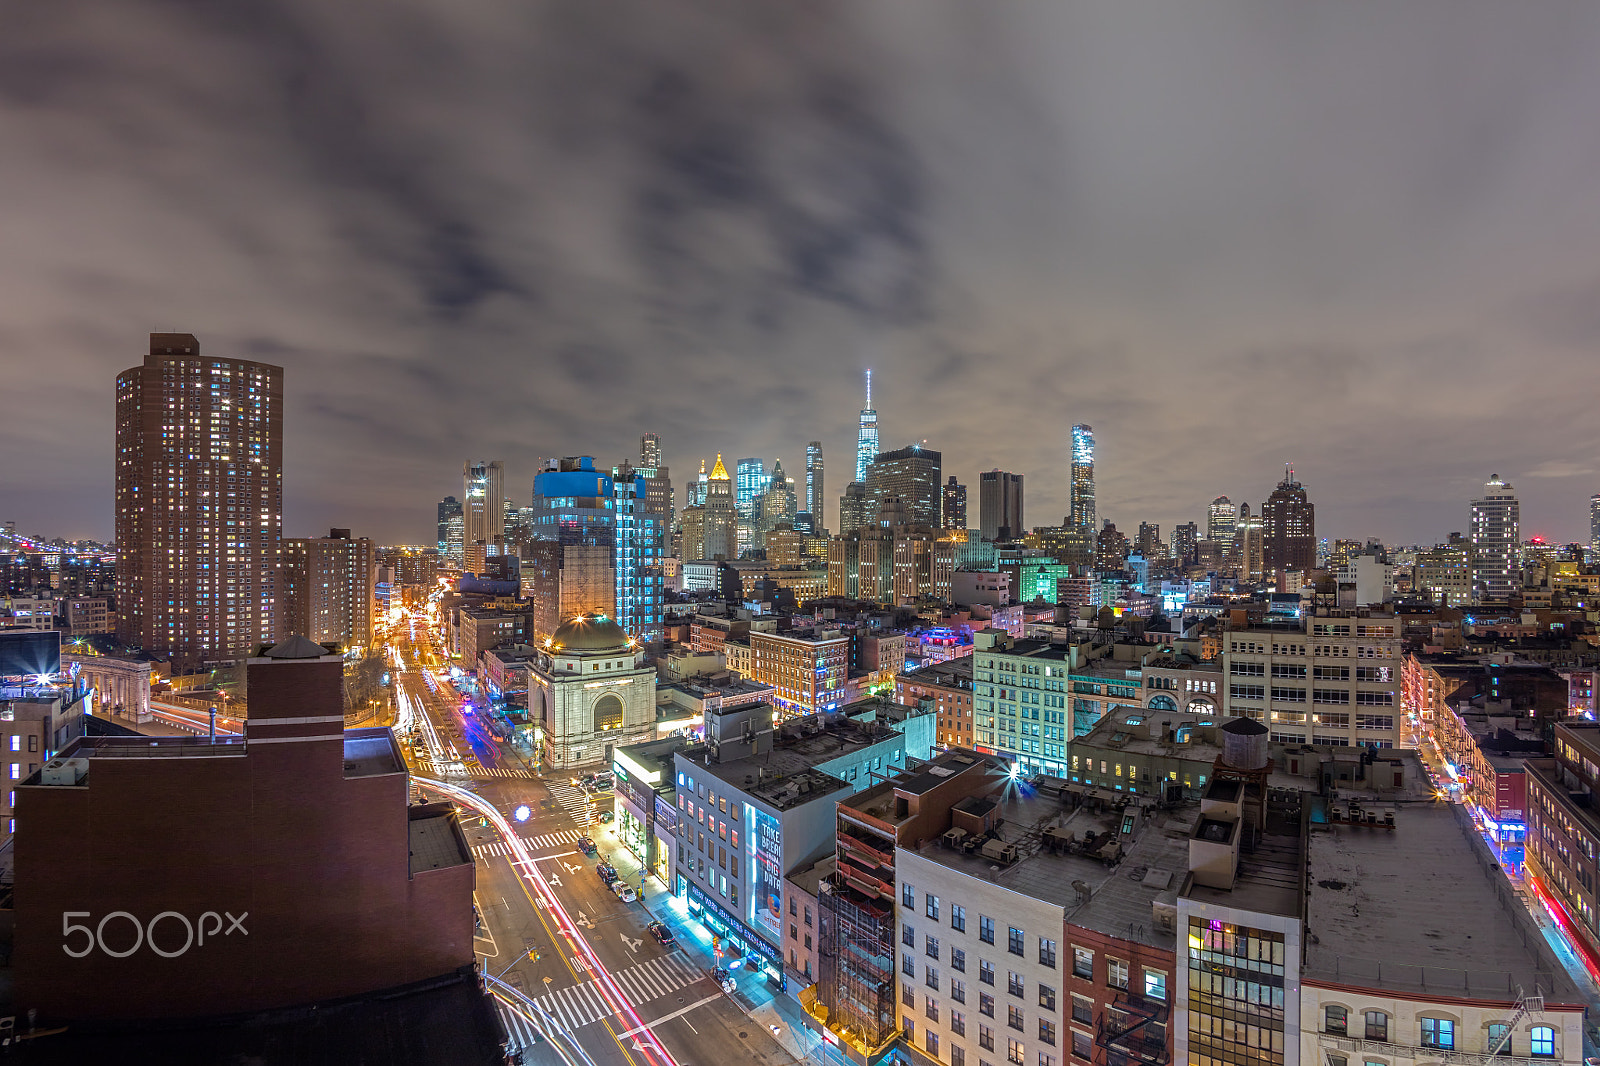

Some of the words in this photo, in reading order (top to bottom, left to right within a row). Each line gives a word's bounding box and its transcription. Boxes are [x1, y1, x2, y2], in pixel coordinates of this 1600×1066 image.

[762, 823, 780, 844] TAKE
[761, 836, 781, 858] BREA
[766, 859, 779, 876] BIG
[764, 870, 781, 891] DATA
